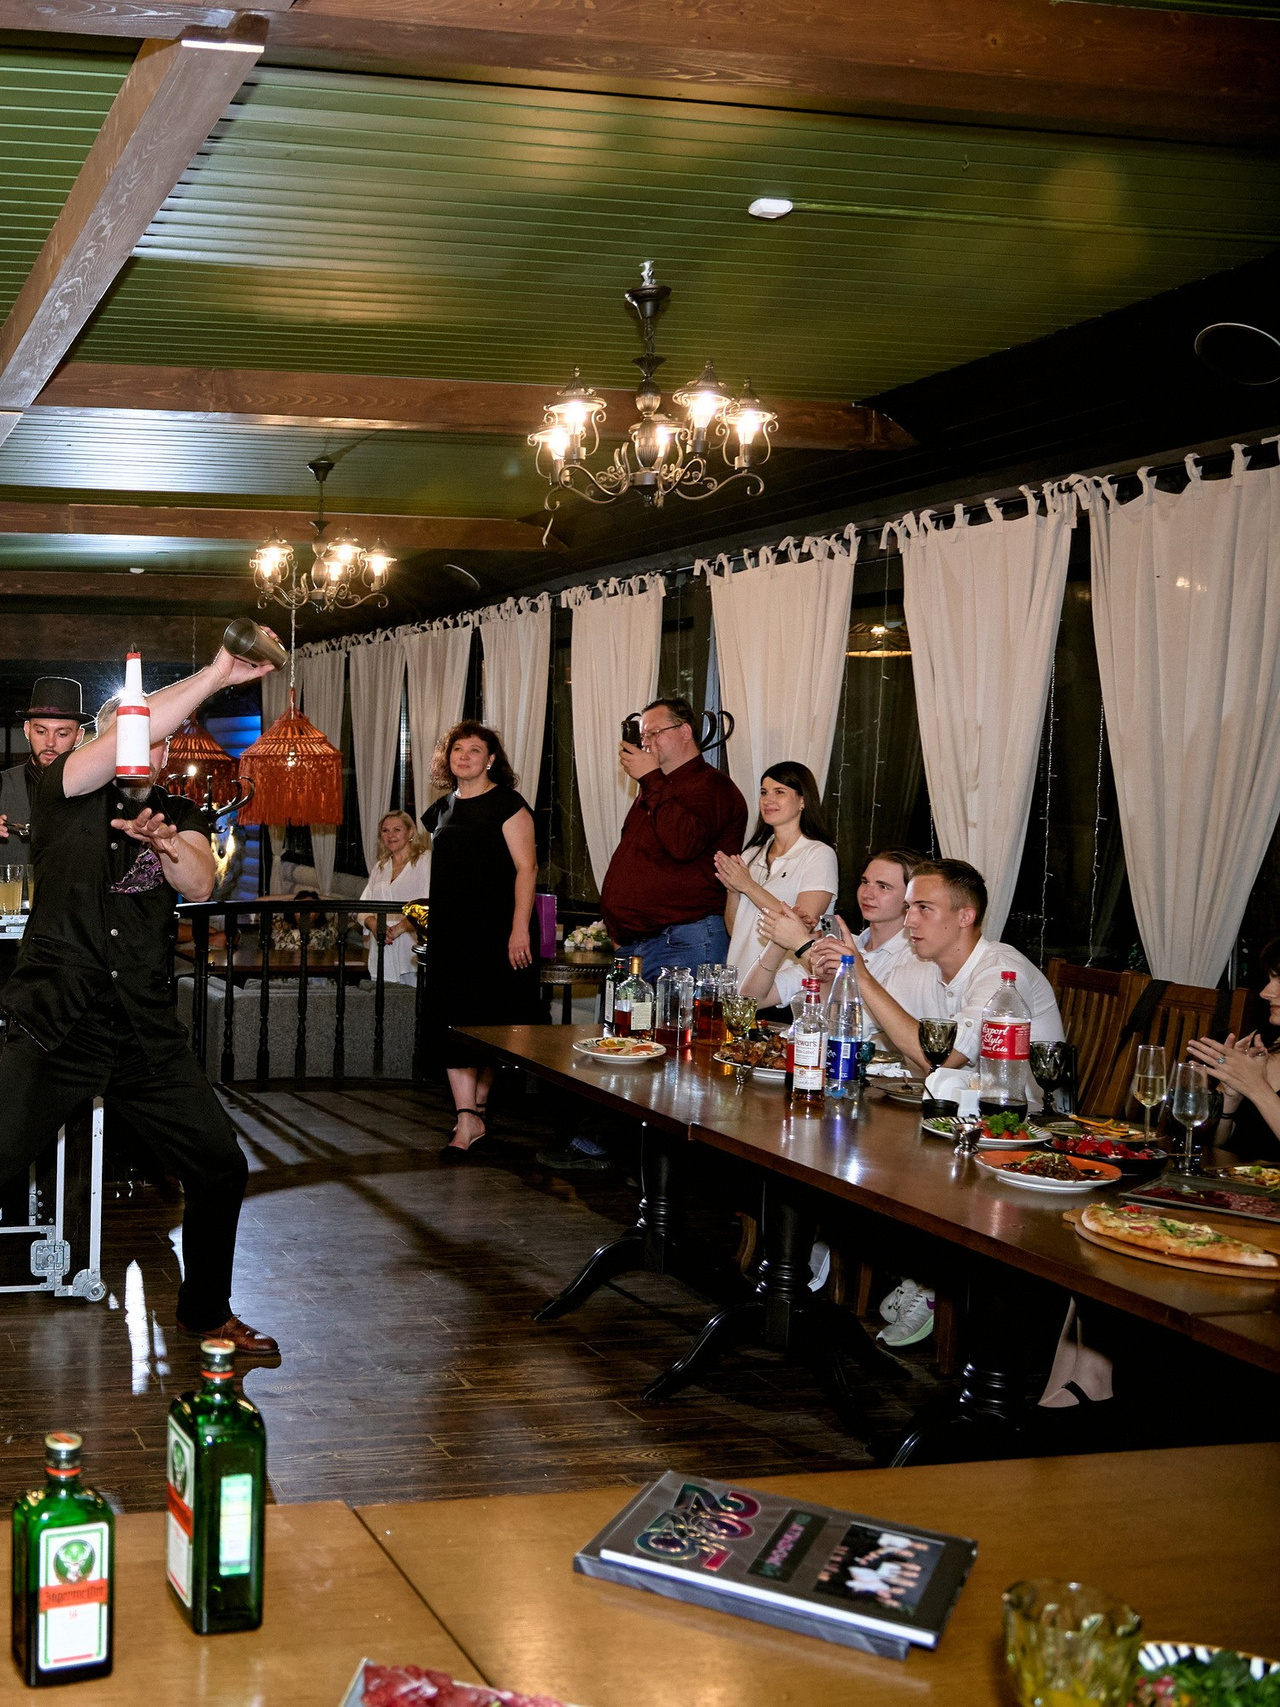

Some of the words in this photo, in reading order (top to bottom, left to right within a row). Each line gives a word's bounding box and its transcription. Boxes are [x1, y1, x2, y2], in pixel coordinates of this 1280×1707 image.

[982, 1023, 1010, 1038] Export
[983, 1034, 1003, 1046] Style
[992, 1043, 1008, 1053] Cola
